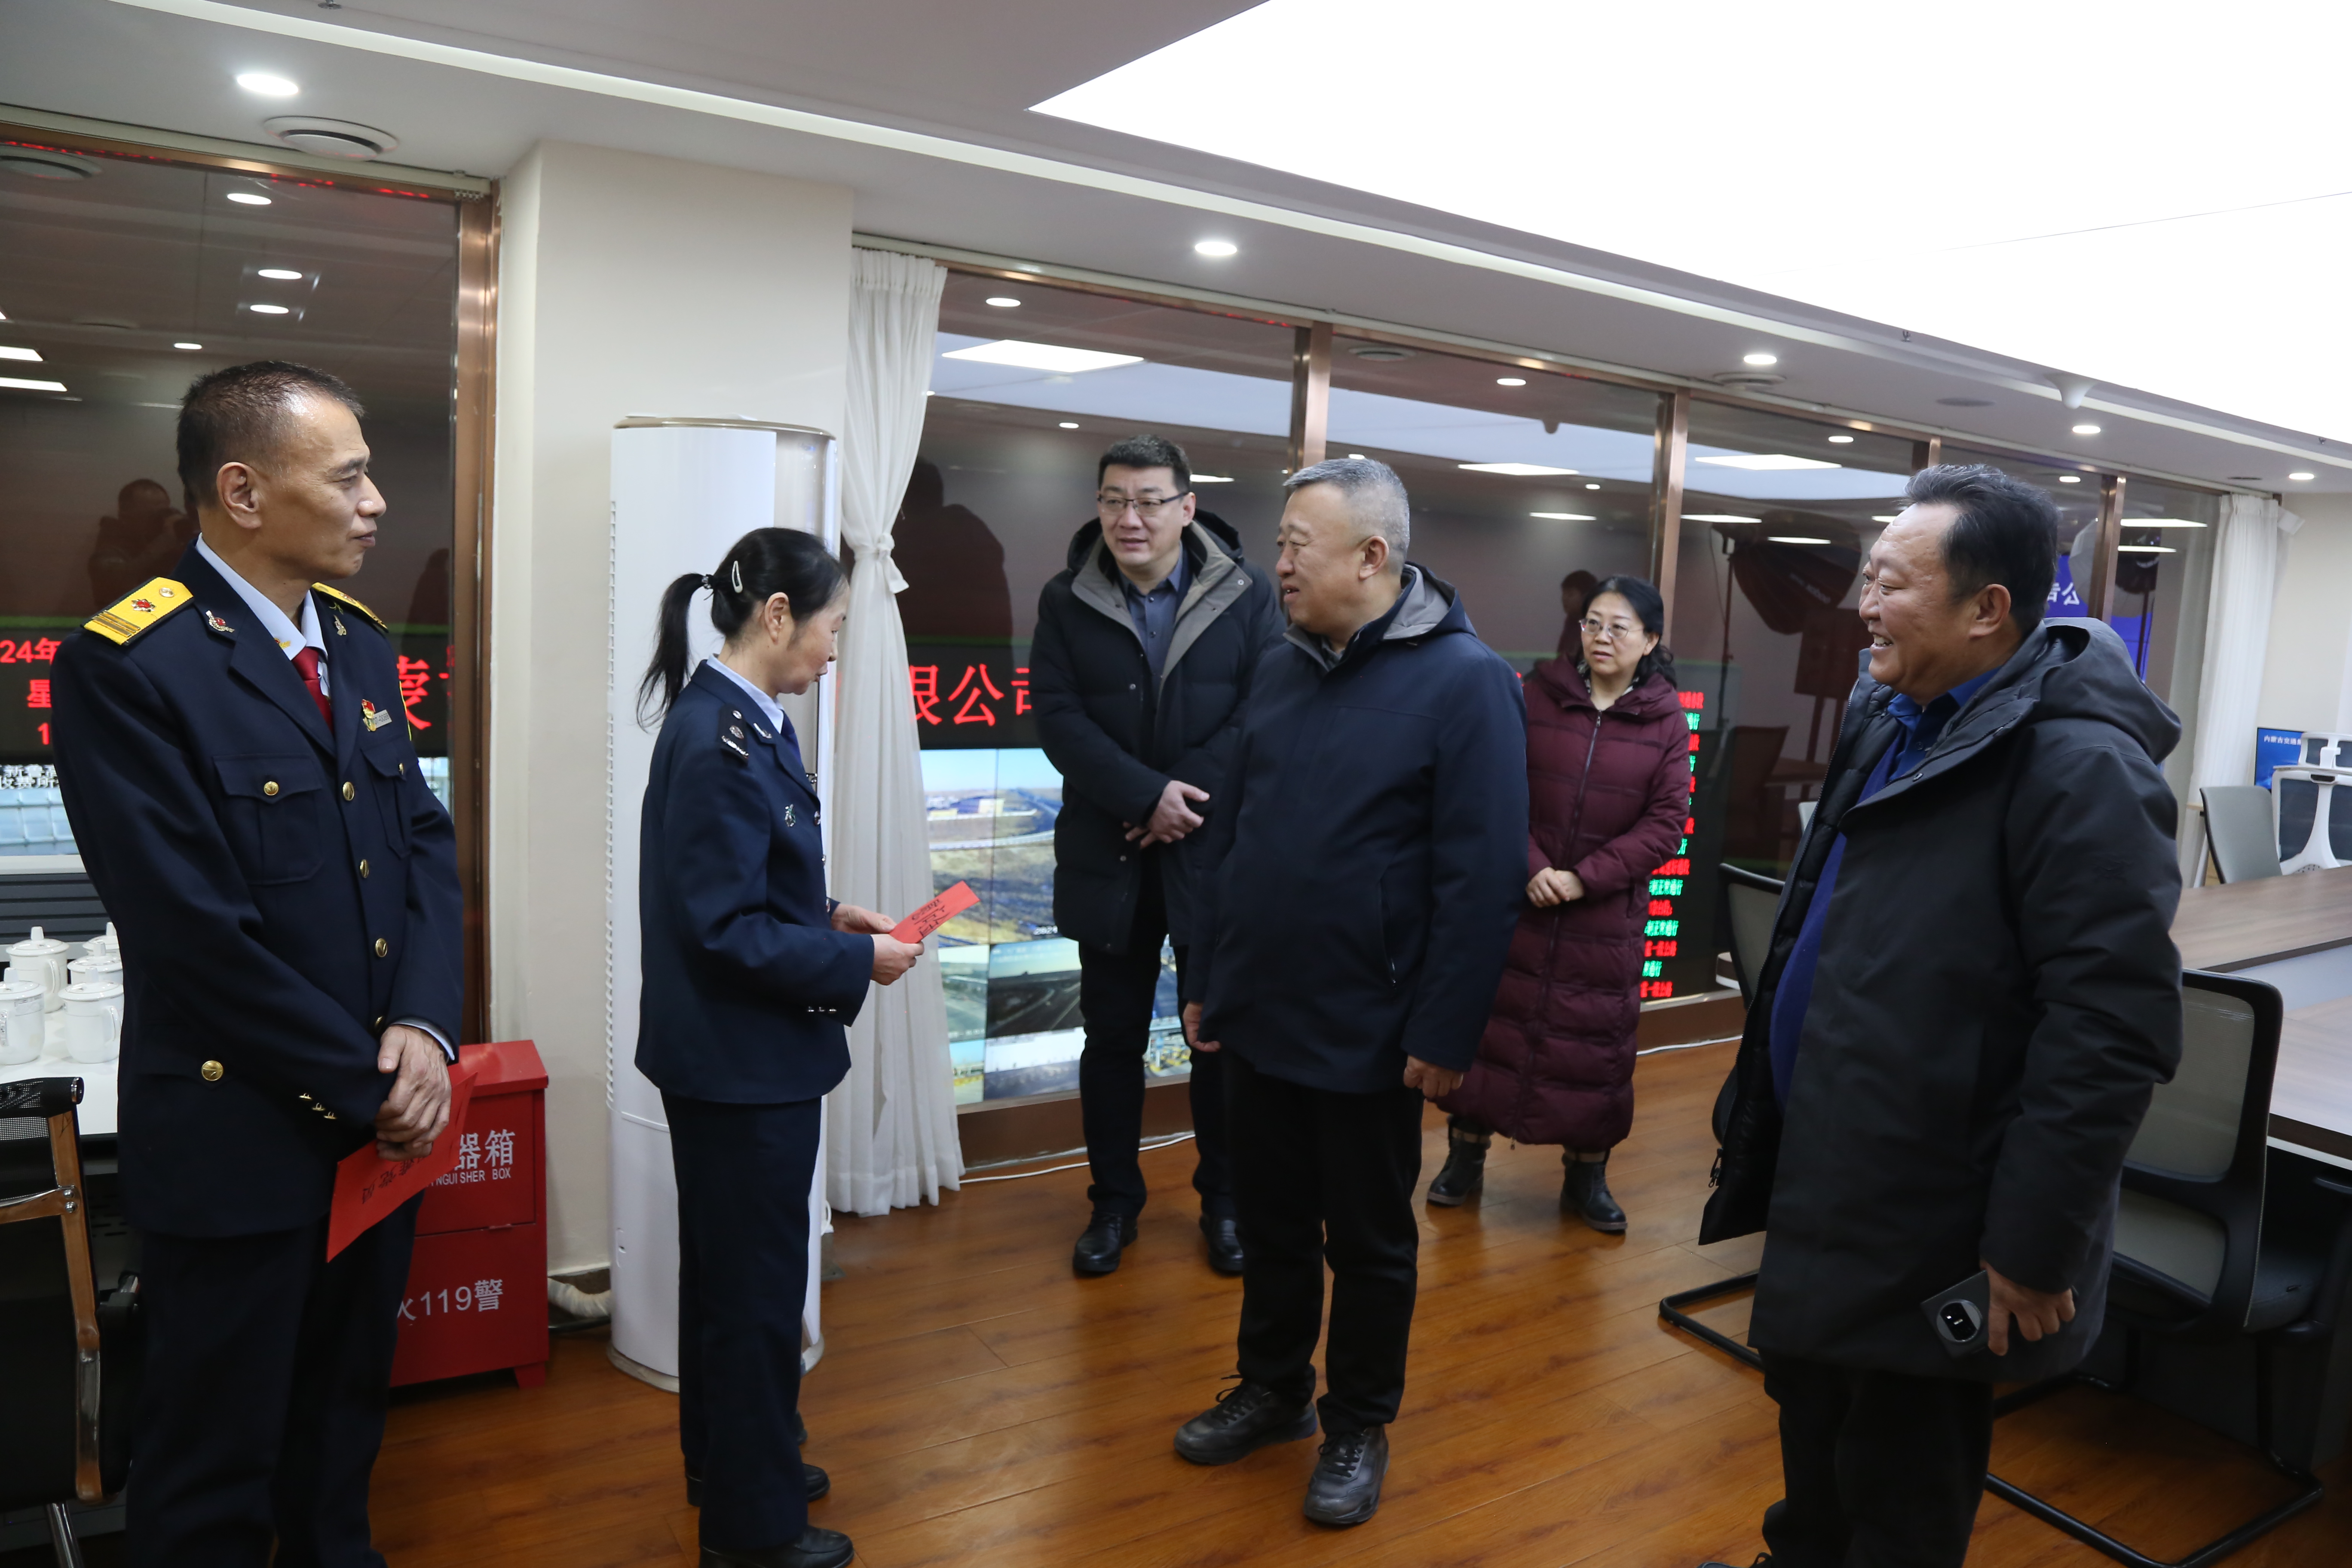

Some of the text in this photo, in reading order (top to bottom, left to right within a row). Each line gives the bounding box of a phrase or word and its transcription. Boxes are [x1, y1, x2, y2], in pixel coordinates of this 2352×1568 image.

[0, 775, 60, 789] 收费所
[492, 1167, 511, 1180] BOX
